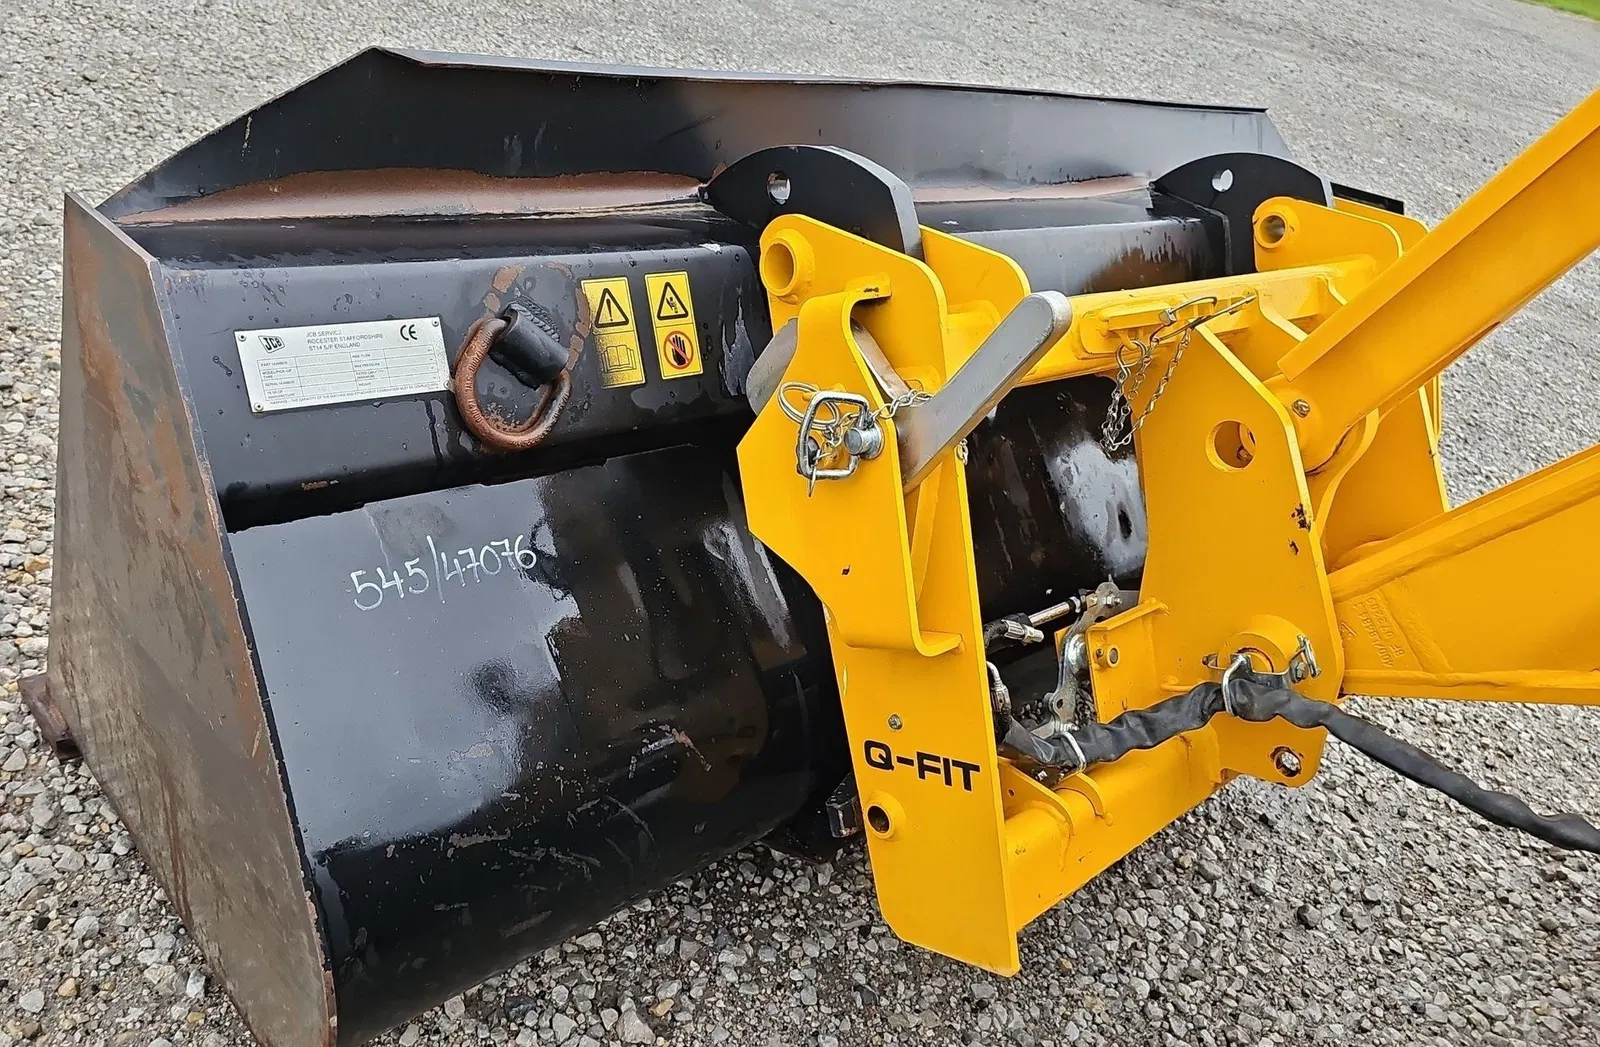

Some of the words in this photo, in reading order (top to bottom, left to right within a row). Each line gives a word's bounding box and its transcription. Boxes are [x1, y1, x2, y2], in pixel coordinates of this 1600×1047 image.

[263, 336, 283, 351] JCB
[307, 336, 339, 344] ROCESTER
[339, 333, 384, 342] STAFFORDSHIRE
[350, 534, 537, 611] 545/47076
[863, 740, 981, 792] Q-FIT
